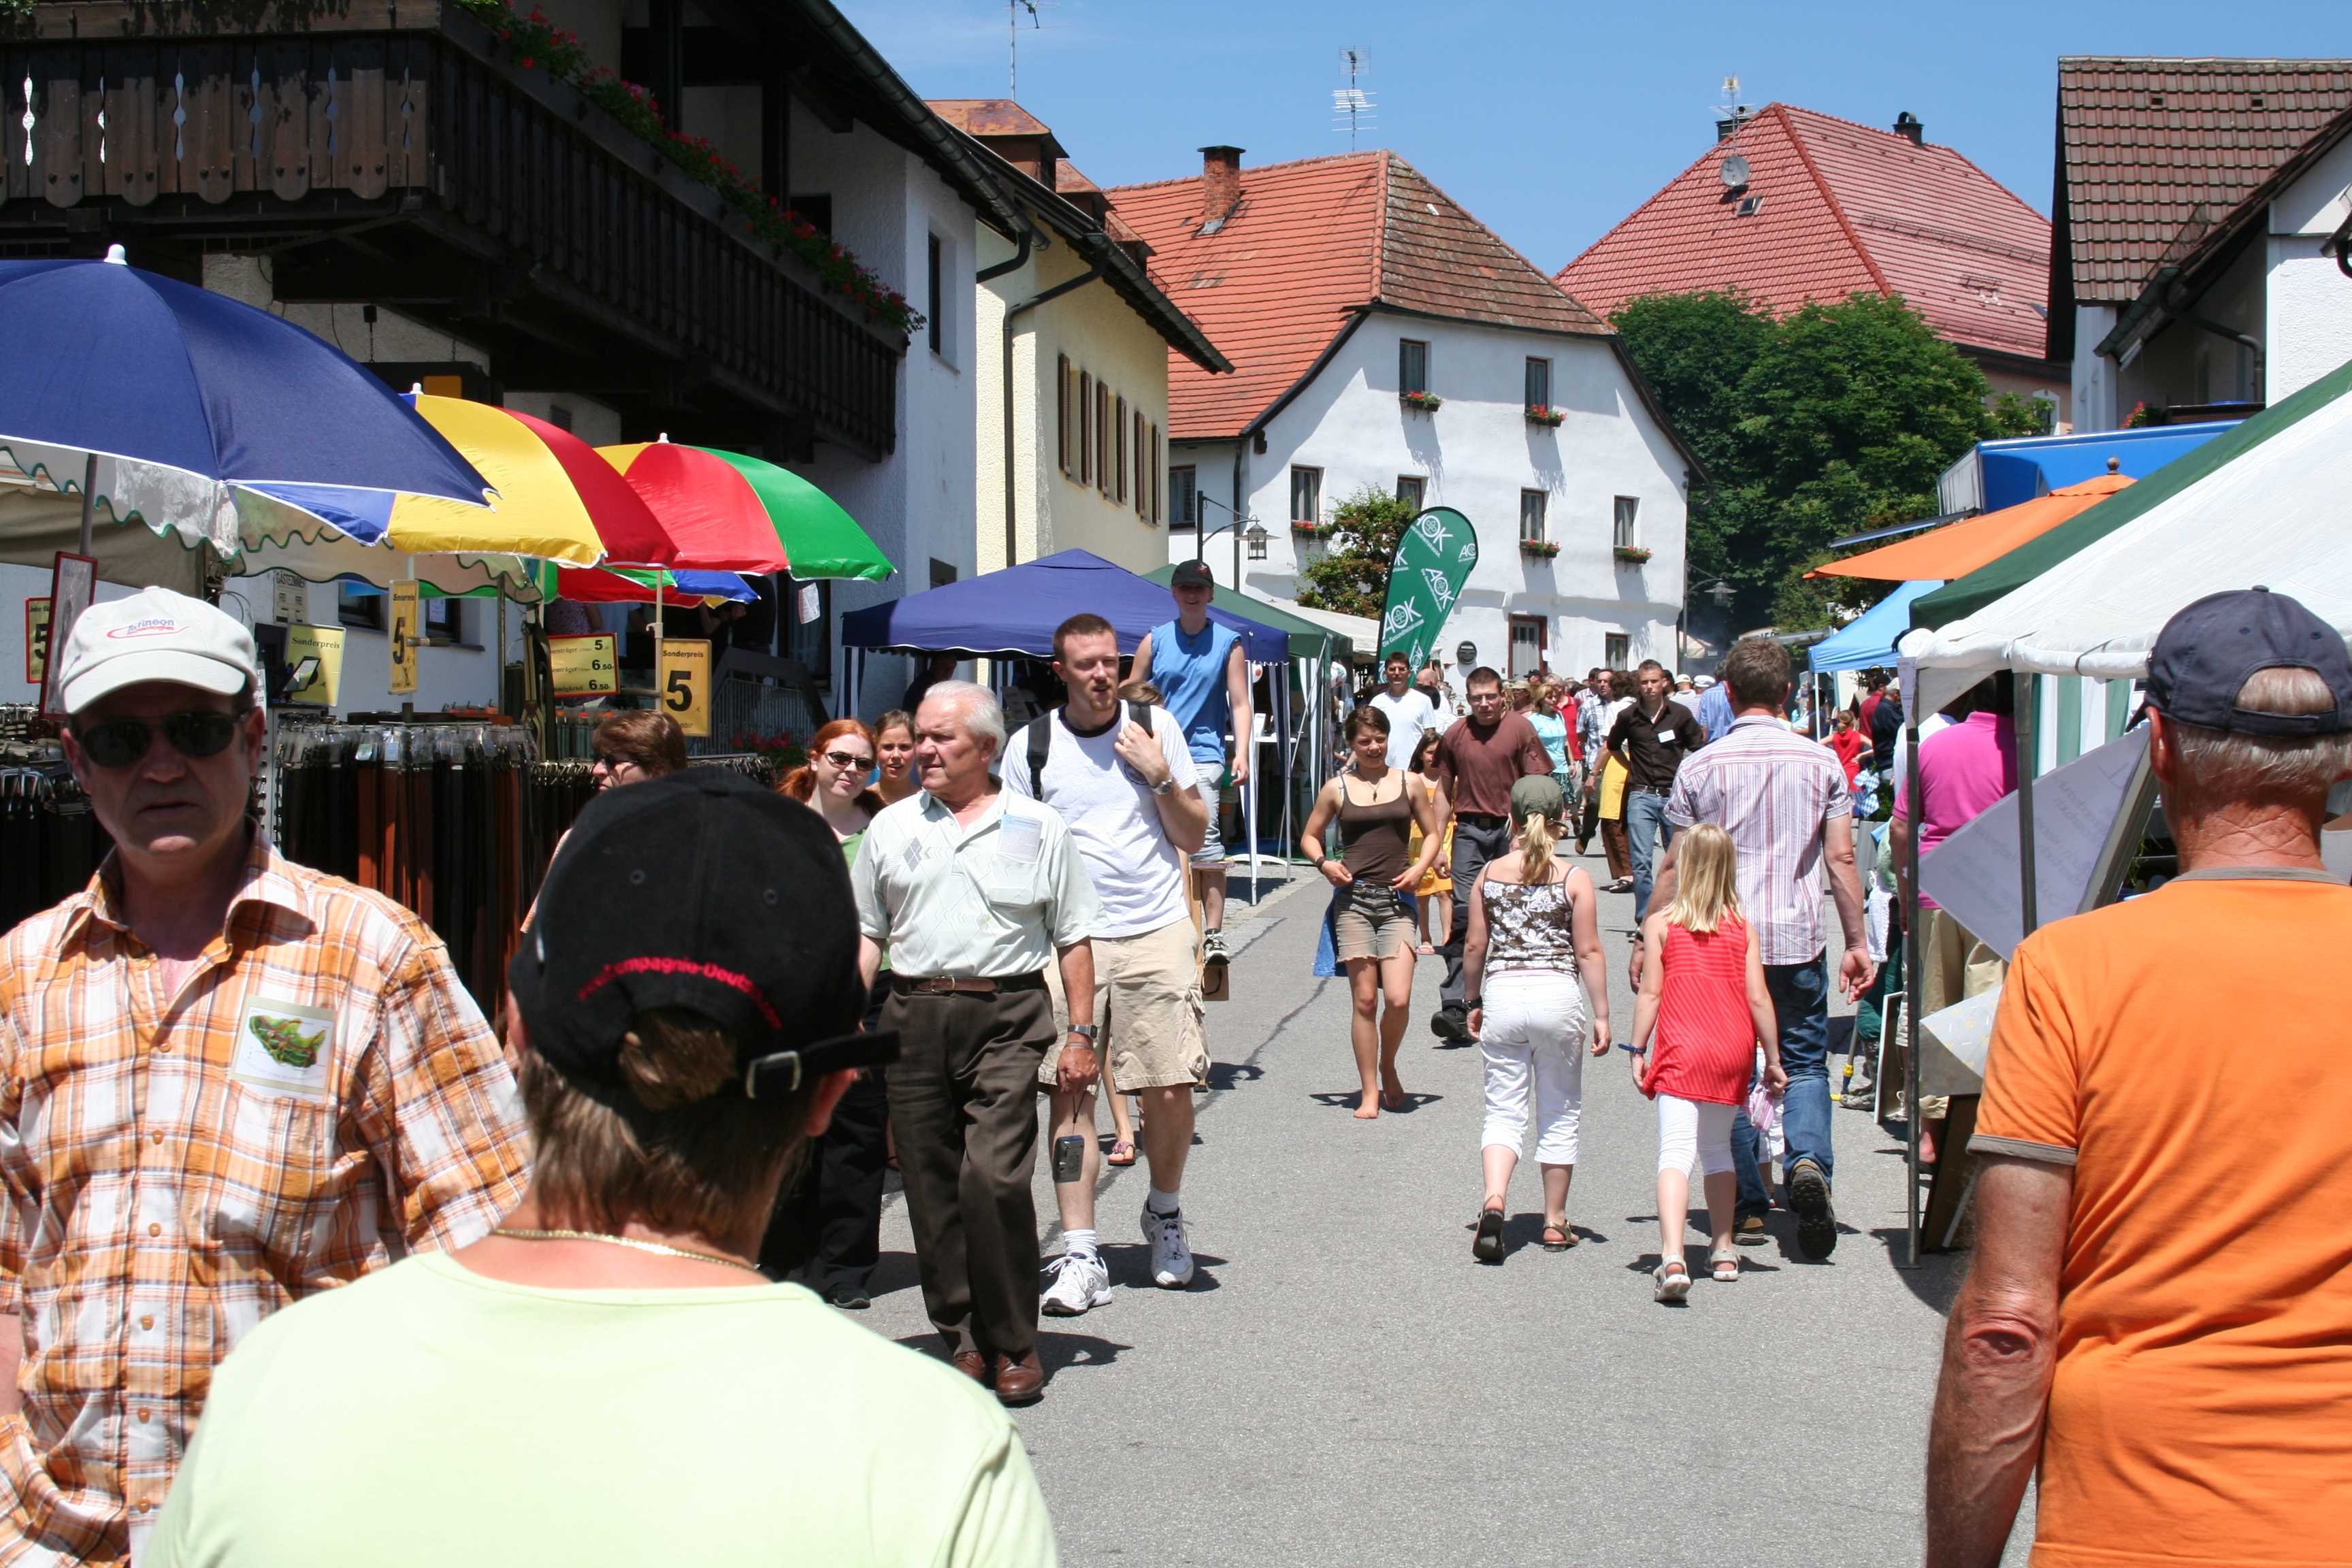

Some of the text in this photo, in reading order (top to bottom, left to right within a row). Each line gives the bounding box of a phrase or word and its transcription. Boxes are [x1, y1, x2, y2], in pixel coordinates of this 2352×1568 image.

[1425, 568, 1455, 610] AOK
[1382, 595, 1422, 640] AOK
[292, 636, 341, 649] Sonderpreis
[393, 617, 406, 665] 5
[663, 650, 704, 659] Sonderpreis
[666, 670, 693, 712] 5
